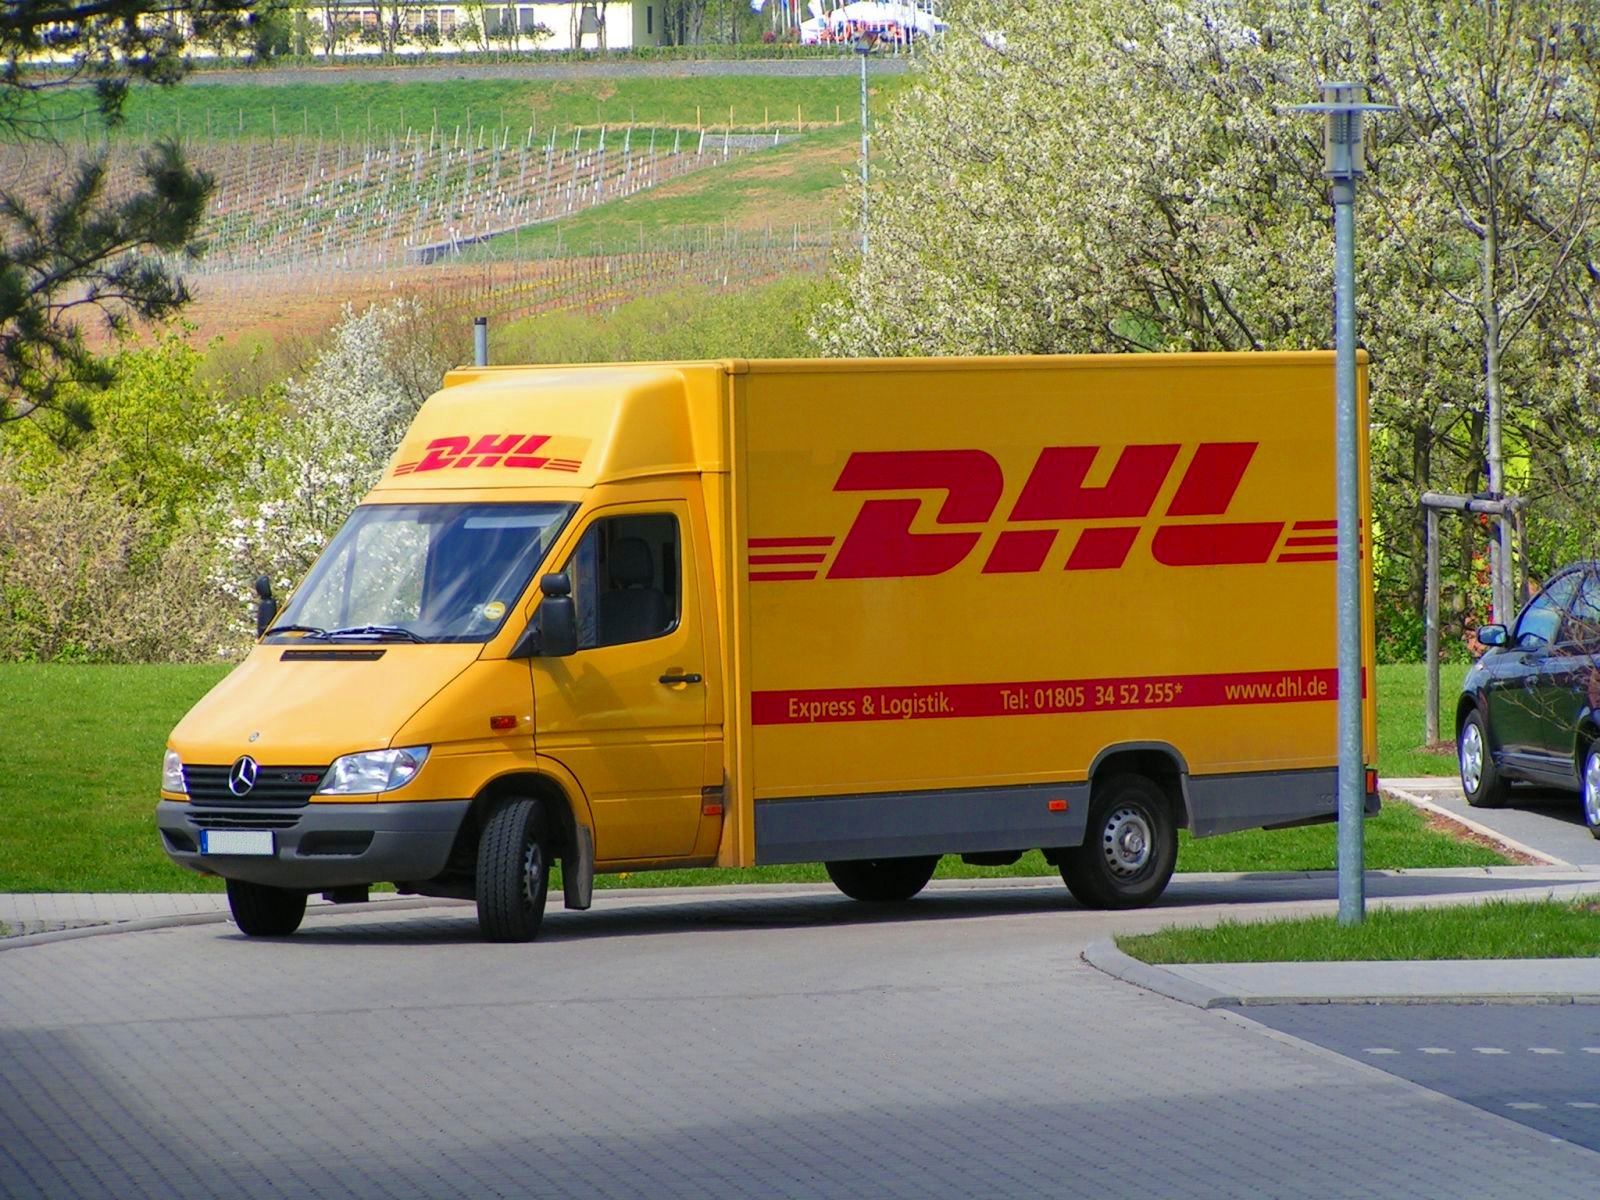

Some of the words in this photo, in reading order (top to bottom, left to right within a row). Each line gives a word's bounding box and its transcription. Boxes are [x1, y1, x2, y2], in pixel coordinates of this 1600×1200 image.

[413, 434, 552, 473] DHL
[825, 441, 1286, 580] DHL
[1000, 688, 1029, 710] Tel:
[1034, 686, 1085, 709] 01805
[1095, 685, 1115, 706] 34
[1120, 684, 1139, 705] 52
[1225, 675, 1328, 700] www.dhl.de
[788, 697, 856, 723] Express
[862, 695, 875, 716] &
[880, 691, 955, 719] Logistik.
